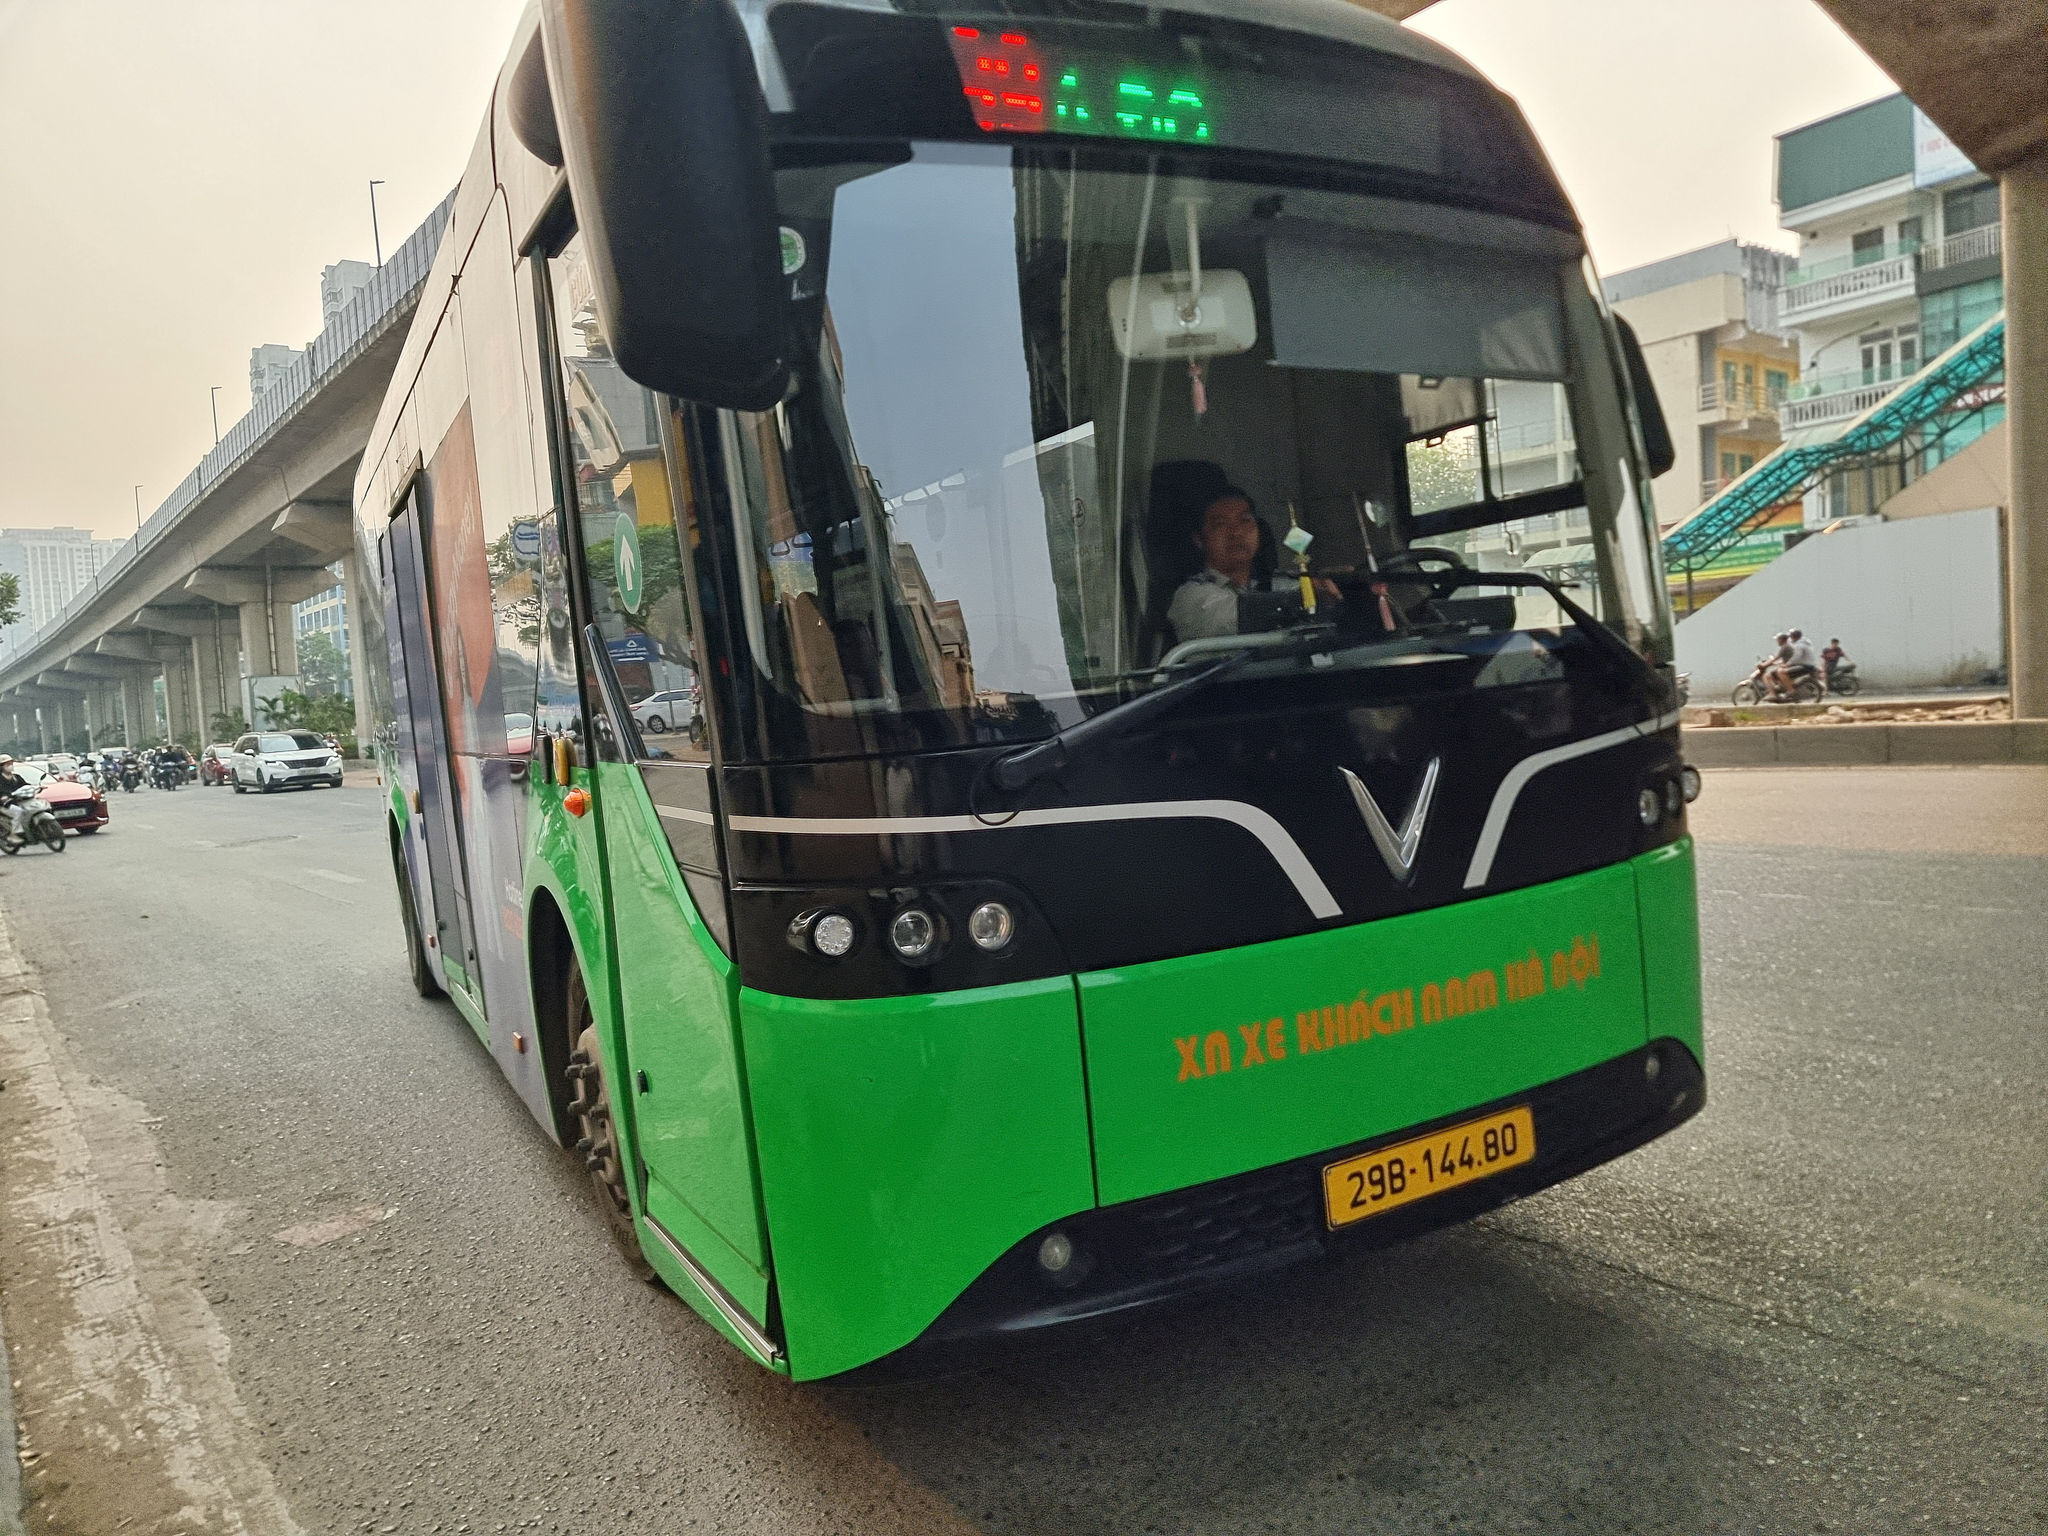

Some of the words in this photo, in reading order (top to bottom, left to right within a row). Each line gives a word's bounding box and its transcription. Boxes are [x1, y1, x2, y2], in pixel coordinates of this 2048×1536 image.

[1174, 1031, 1232, 1082] XN
[1238, 1017, 1287, 1068] XE
[1296, 988, 1415, 1055] KHÁCH
[1421, 968, 1499, 1025] NAM
[1346, 1122, 1518, 1209] 29B-144.80
